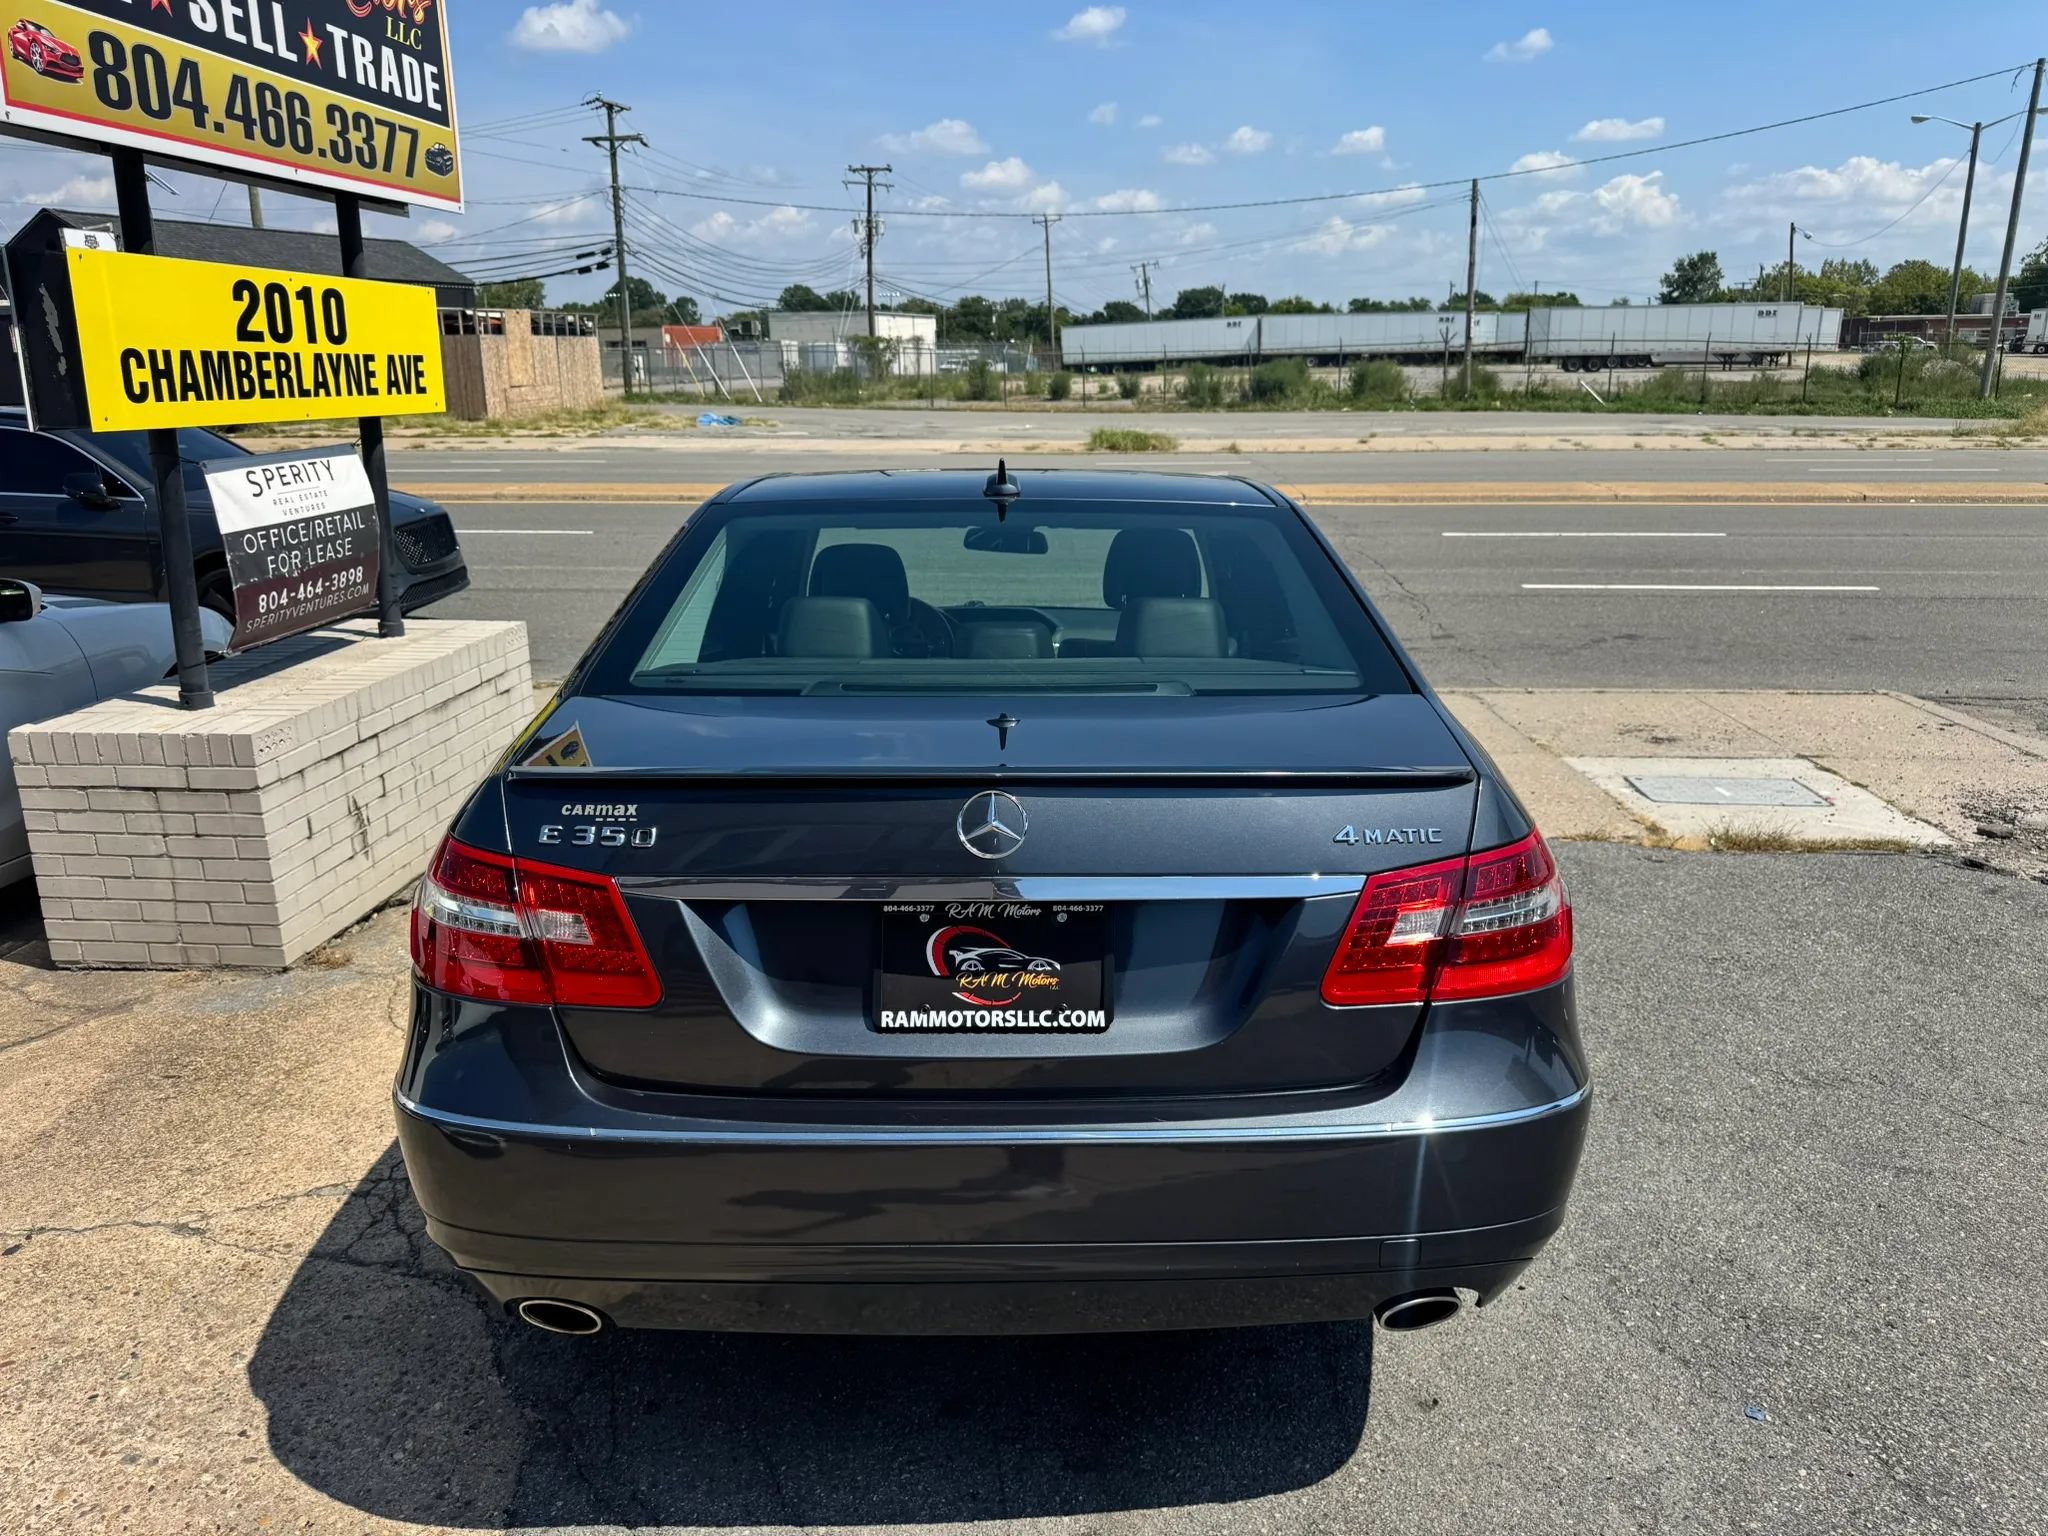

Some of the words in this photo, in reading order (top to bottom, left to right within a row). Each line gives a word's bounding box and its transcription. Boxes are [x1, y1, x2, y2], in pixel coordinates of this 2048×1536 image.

[385, 15, 422, 50] LLC
[189, 0, 298, 63] SELL
[326, 24, 442, 112] TRADE
[87, 29, 420, 179] 804.466.3377
[232, 279, 347, 346] 2010
[120, 347, 379, 404] CHAMBERLAYNE
[386, 354, 427, 395] AVE
[246, 460, 335, 498] SPERITY
[273, 497, 295, 506] REAL
[299, 490, 328, 502] ESTATE
[282, 502, 326, 516] VENTURES
[243, 511, 366, 554] OFFICE/RETAIL
[267, 551, 301, 577] FOR
[307, 537, 353, 566] LEASE
[246, 583, 369, 633] SPERITYVENTURES.COM
[258, 566, 363, 614] 804-464-3898
[538, 825, 564, 844] E
[571, 824, 657, 848] 350
[945, 903, 995, 919] RAM
[998, 903, 1042, 918] Motors
[956, 972, 1010, 989] RAM
[1012, 972, 1060, 988] Motors
[881, 1010, 1106, 1028] RAMMOTORSLLC.COM
